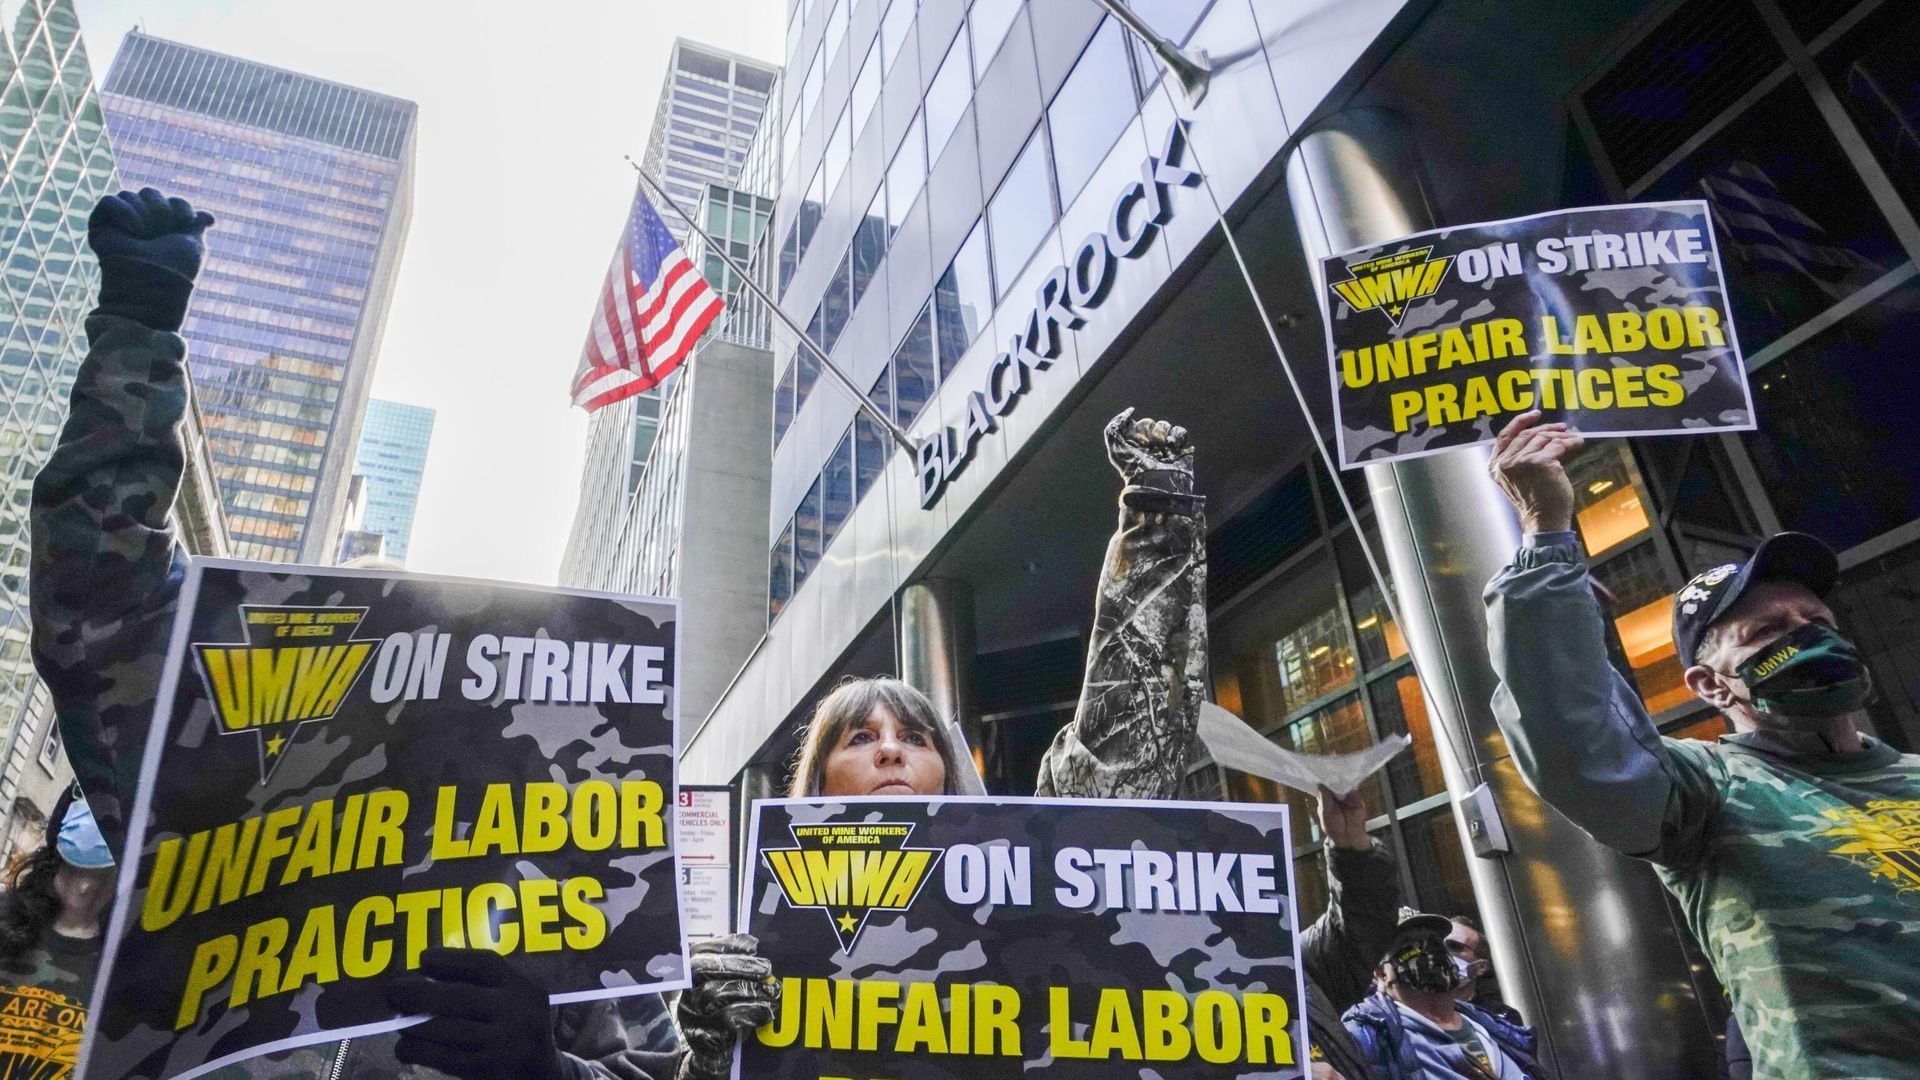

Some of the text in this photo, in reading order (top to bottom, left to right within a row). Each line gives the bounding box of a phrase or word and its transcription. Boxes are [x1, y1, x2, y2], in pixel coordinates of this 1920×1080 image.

[1335, 259, 1448, 311] UMWA
[1456, 229, 1706, 283] ON STRIKE
[918, 118, 1204, 510] BLACKROCK
[1342, 306, 1726, 388] UNFAIR LABOR
[1390, 364, 1685, 433] PRACTICES
[203, 643, 373, 730] UMWA
[370, 632, 666, 705] ON STRIKE
[1754, 645, 1800, 676] UMWA
[679, 791, 689, 806] 3
[709, 819, 727, 827] ONLY
[141, 780, 667, 932] UNFAIR LABOR
[797, 827, 908, 836] UNITED MINE WORKERS
[822, 835, 880, 844] OF AMERICA
[768, 850, 932, 907] UMWA
[944, 844, 1280, 915] ON STRIKE
[175, 876, 608, 1031] PRACTICES
[3, 996, 52, 1019] ARE
[756, 977, 1296, 1065] UNFAIR LABOR
